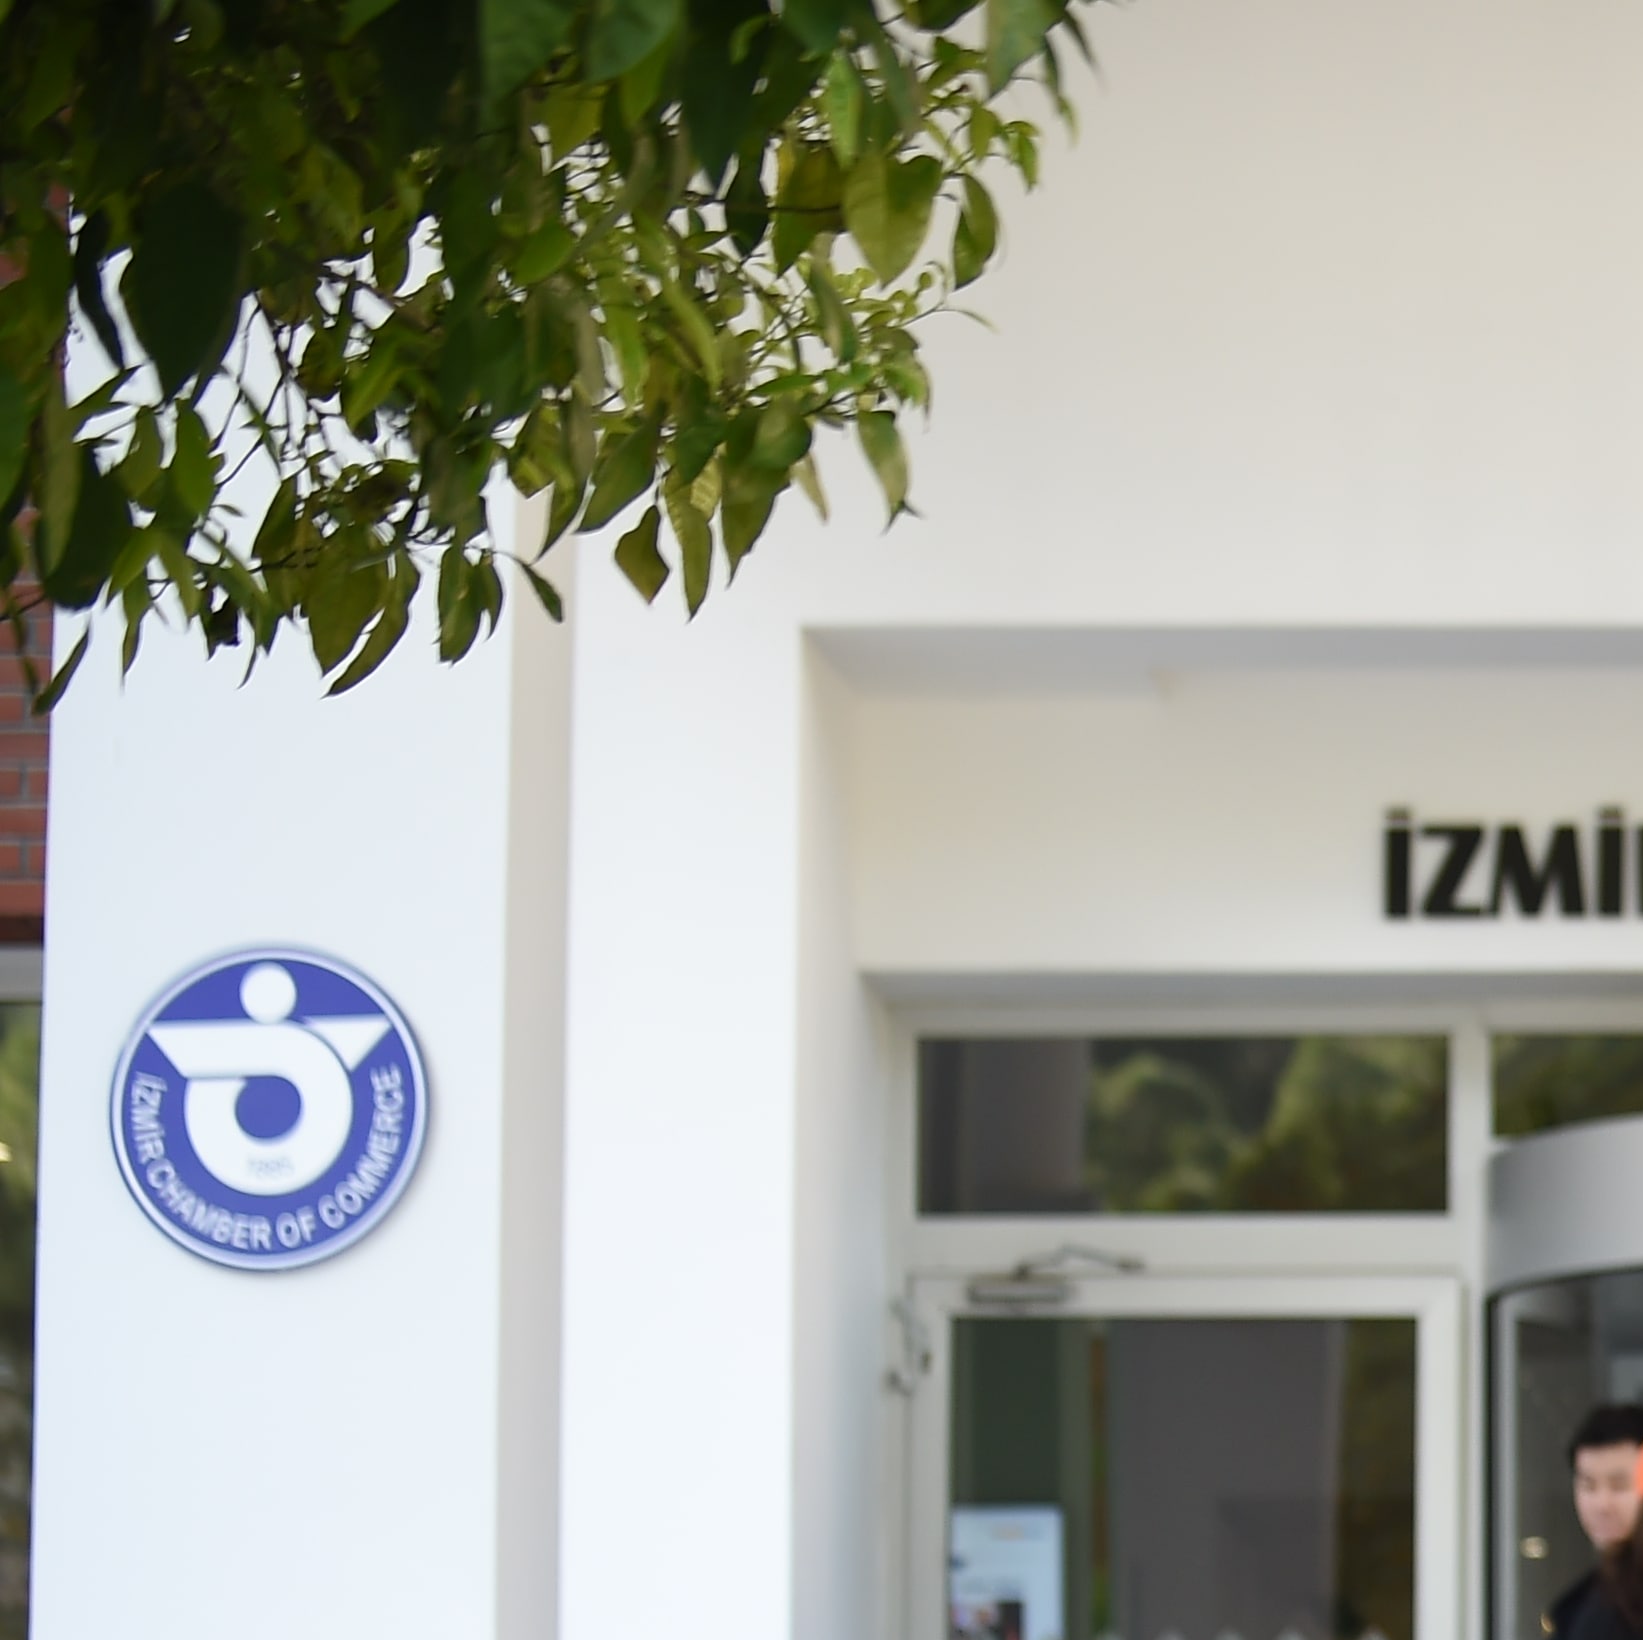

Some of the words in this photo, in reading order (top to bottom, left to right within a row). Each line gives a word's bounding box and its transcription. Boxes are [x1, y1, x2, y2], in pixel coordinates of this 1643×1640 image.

[146, 1158, 273, 1250] CHAMBER
[276, 1205, 319, 1249] OF
[318, 1063, 404, 1231] COMMERCE
